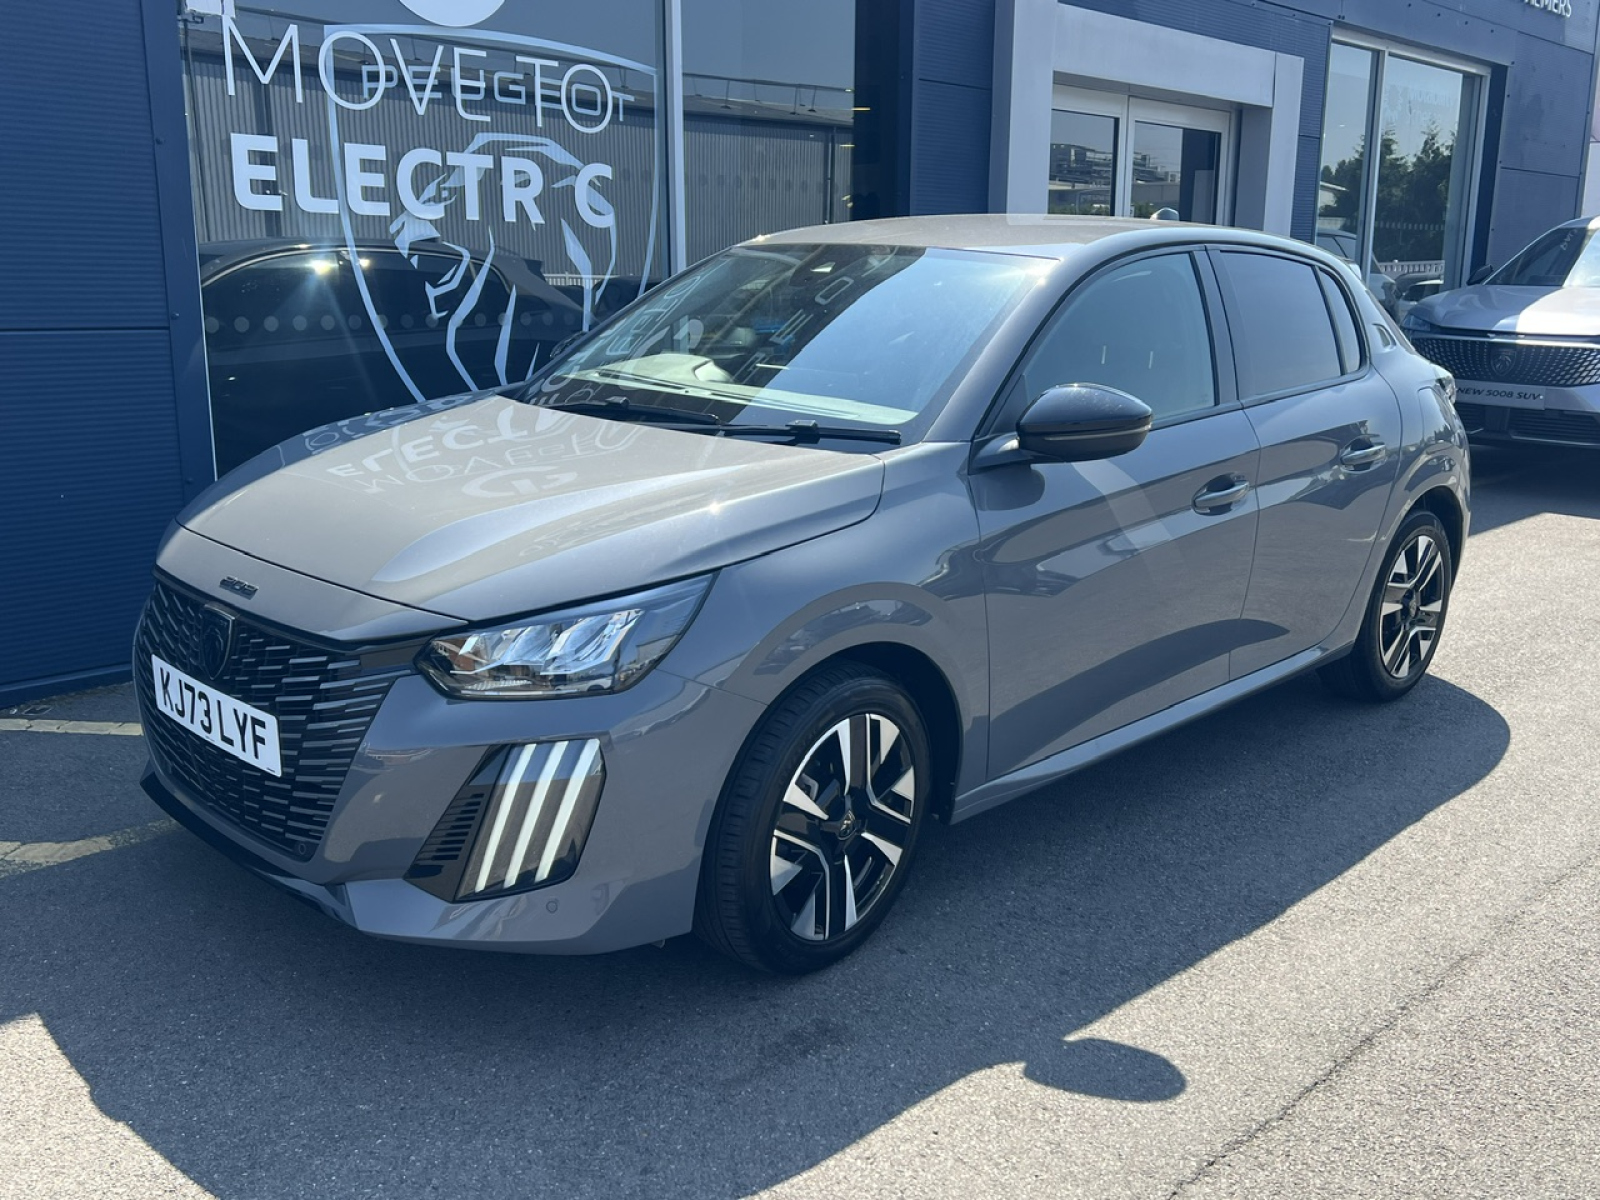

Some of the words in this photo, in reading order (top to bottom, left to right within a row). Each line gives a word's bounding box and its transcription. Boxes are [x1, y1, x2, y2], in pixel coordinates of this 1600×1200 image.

[222, 14, 491, 122] MOVE
[515, 54, 614, 134] TO
[360, 64, 635, 122] PEUGEOT
[1456, 386, 1484, 396] NEW
[1486, 388, 1514, 399] 5008
[1516, 391, 1541, 401] SUV
[159, 666, 213, 735] KJ73
[216, 699, 267, 760] LYF
